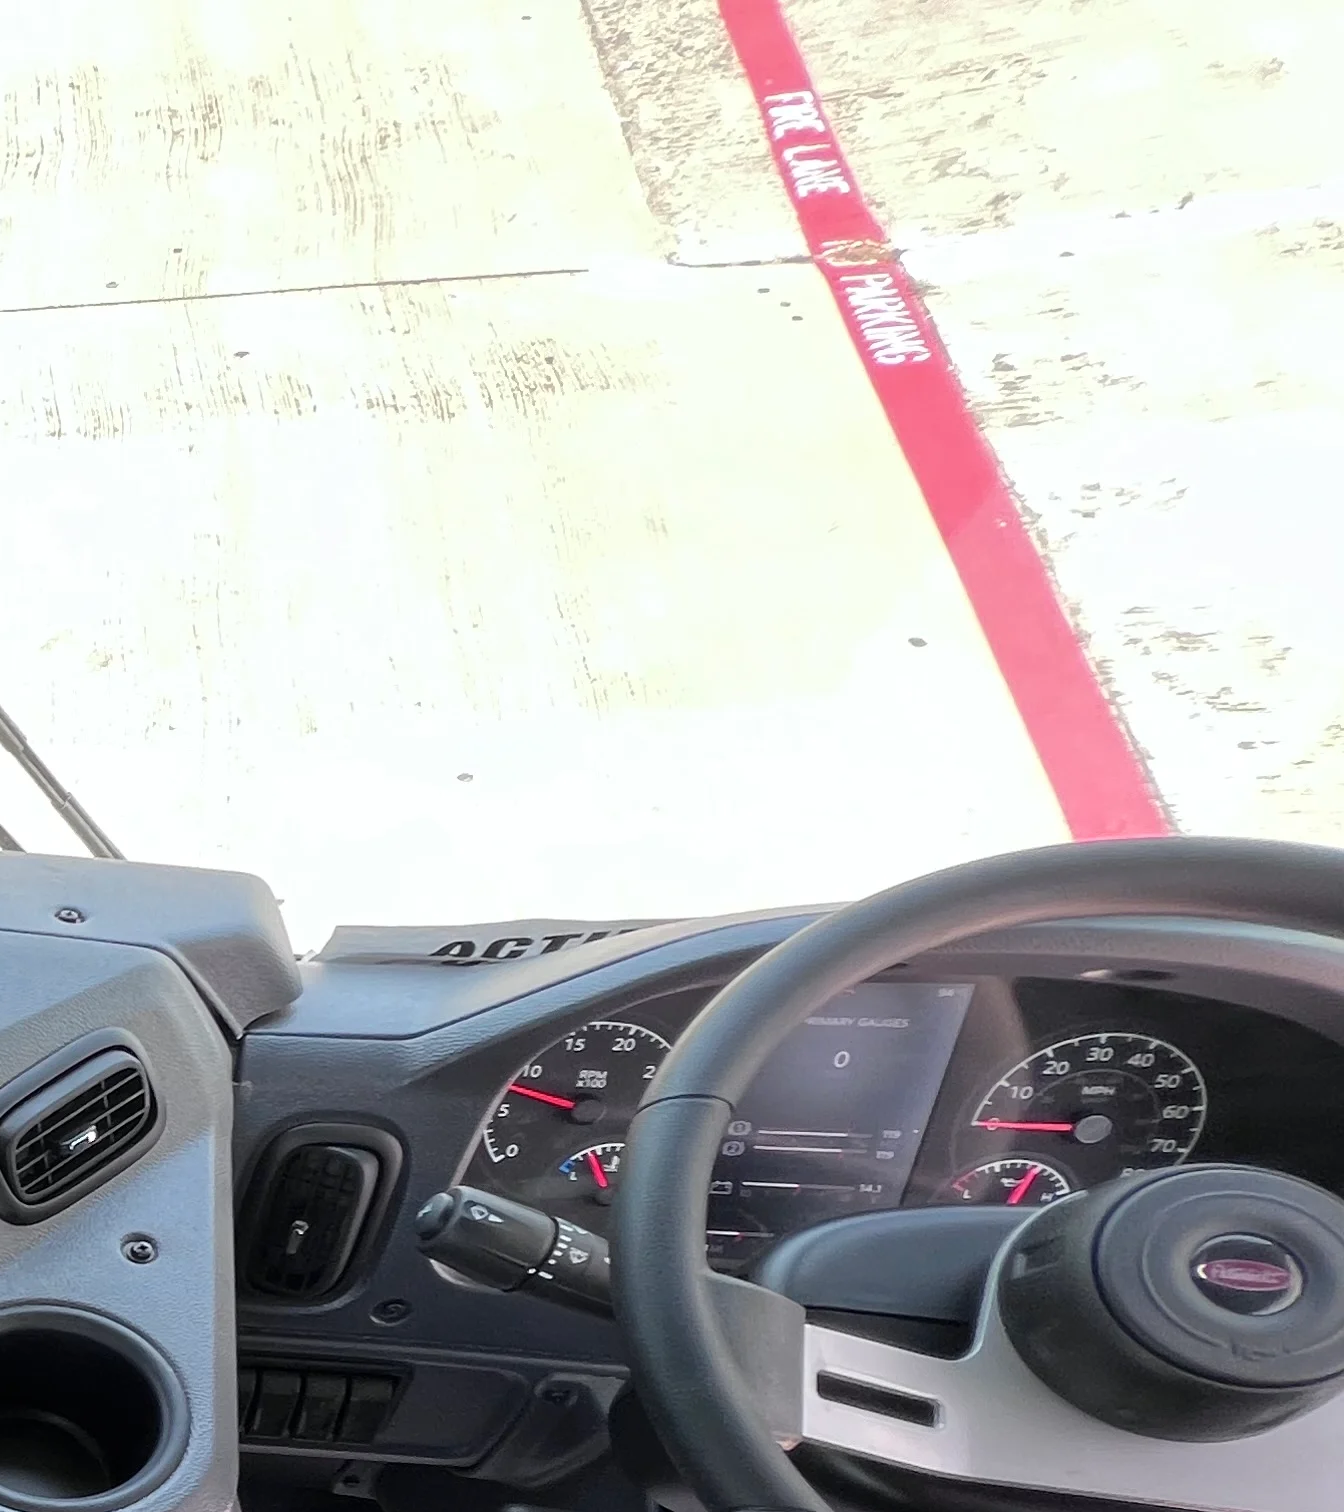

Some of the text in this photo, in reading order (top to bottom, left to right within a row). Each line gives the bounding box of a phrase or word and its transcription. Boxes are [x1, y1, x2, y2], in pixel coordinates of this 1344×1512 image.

[764, 90, 850, 198] FIRE LANE
[839, 272, 932, 364] PARKING
[564, 1037, 586, 1052] 15
[612, 1037, 636, 1052] 20
[833, 1051, 851, 1069] 0
[1086, 1047, 1114, 1063] 30
[1127, 1053, 1155, 1068] 40
[521, 1065, 543, 1079] 10
[579, 1069, 608, 1079] RPM
[1043, 1060, 1070, 1076] 20
[1154, 1074, 1181, 1090] 50
[1010, 1085, 1034, 1100] 10
[497, 1103, 510, 1117] 5
[1162, 1105, 1190, 1120] 60
[505, 1144, 520, 1158] 0
[1150, 1139, 1177, 1153] 70
